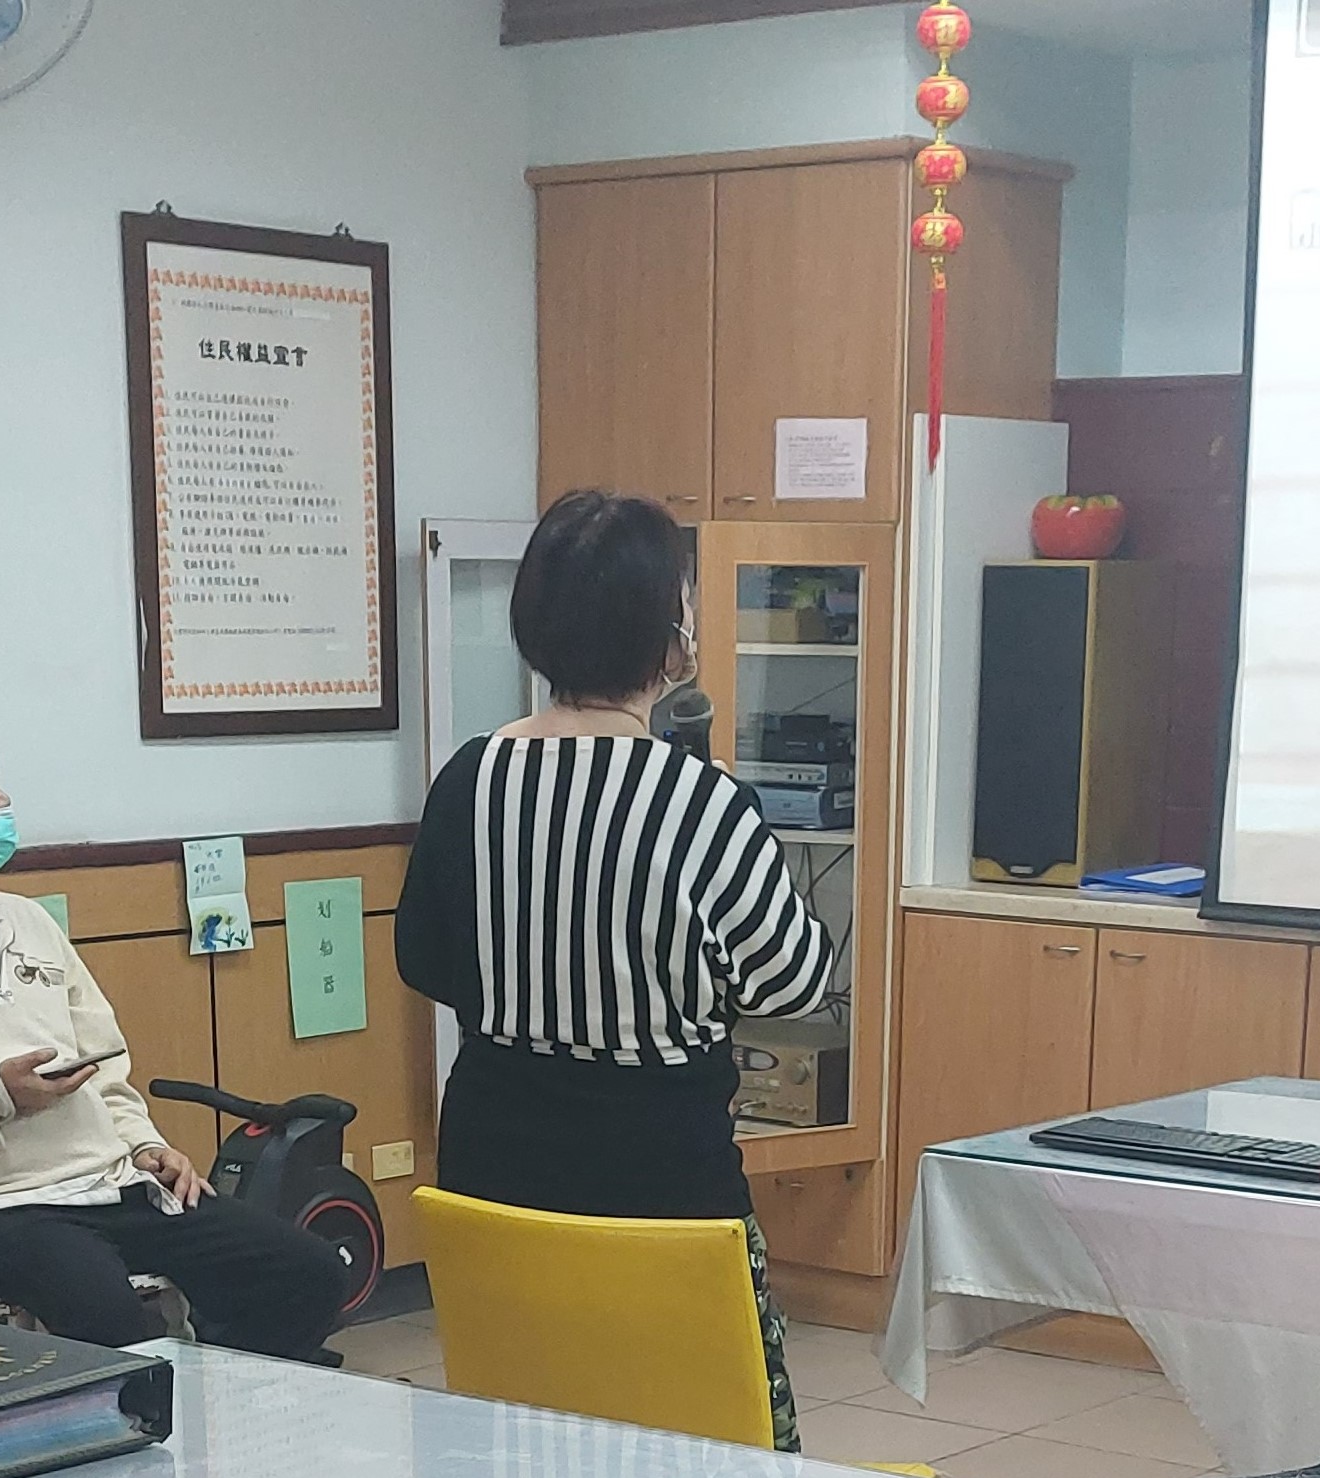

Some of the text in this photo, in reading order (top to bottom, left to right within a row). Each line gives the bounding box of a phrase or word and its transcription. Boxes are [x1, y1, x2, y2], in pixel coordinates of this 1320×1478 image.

[198, 337, 309, 368] 住民權益宣言
